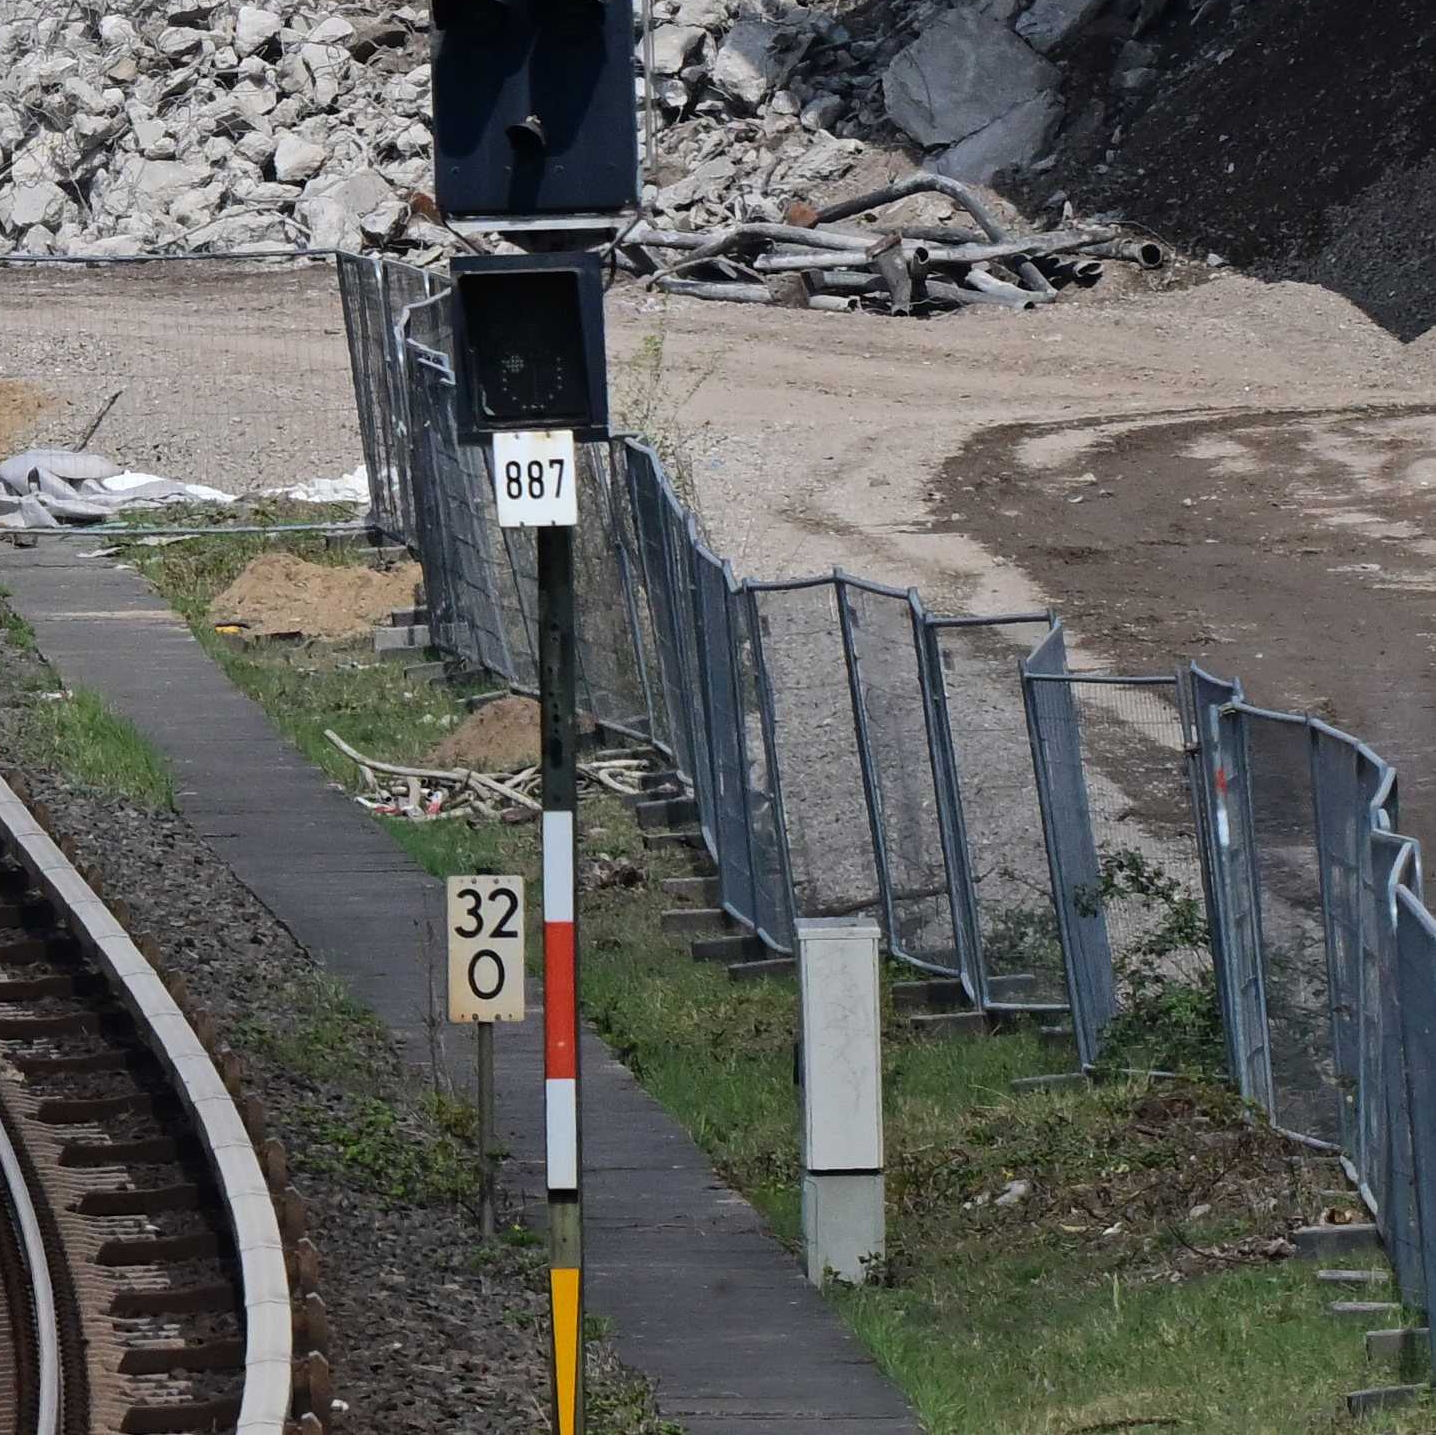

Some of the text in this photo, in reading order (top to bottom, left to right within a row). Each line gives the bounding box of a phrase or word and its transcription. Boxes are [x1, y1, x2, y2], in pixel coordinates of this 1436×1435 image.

[505, 459, 565, 500] 887
[454, 888, 519, 939] 32
[468, 949, 505, 1000] 0
